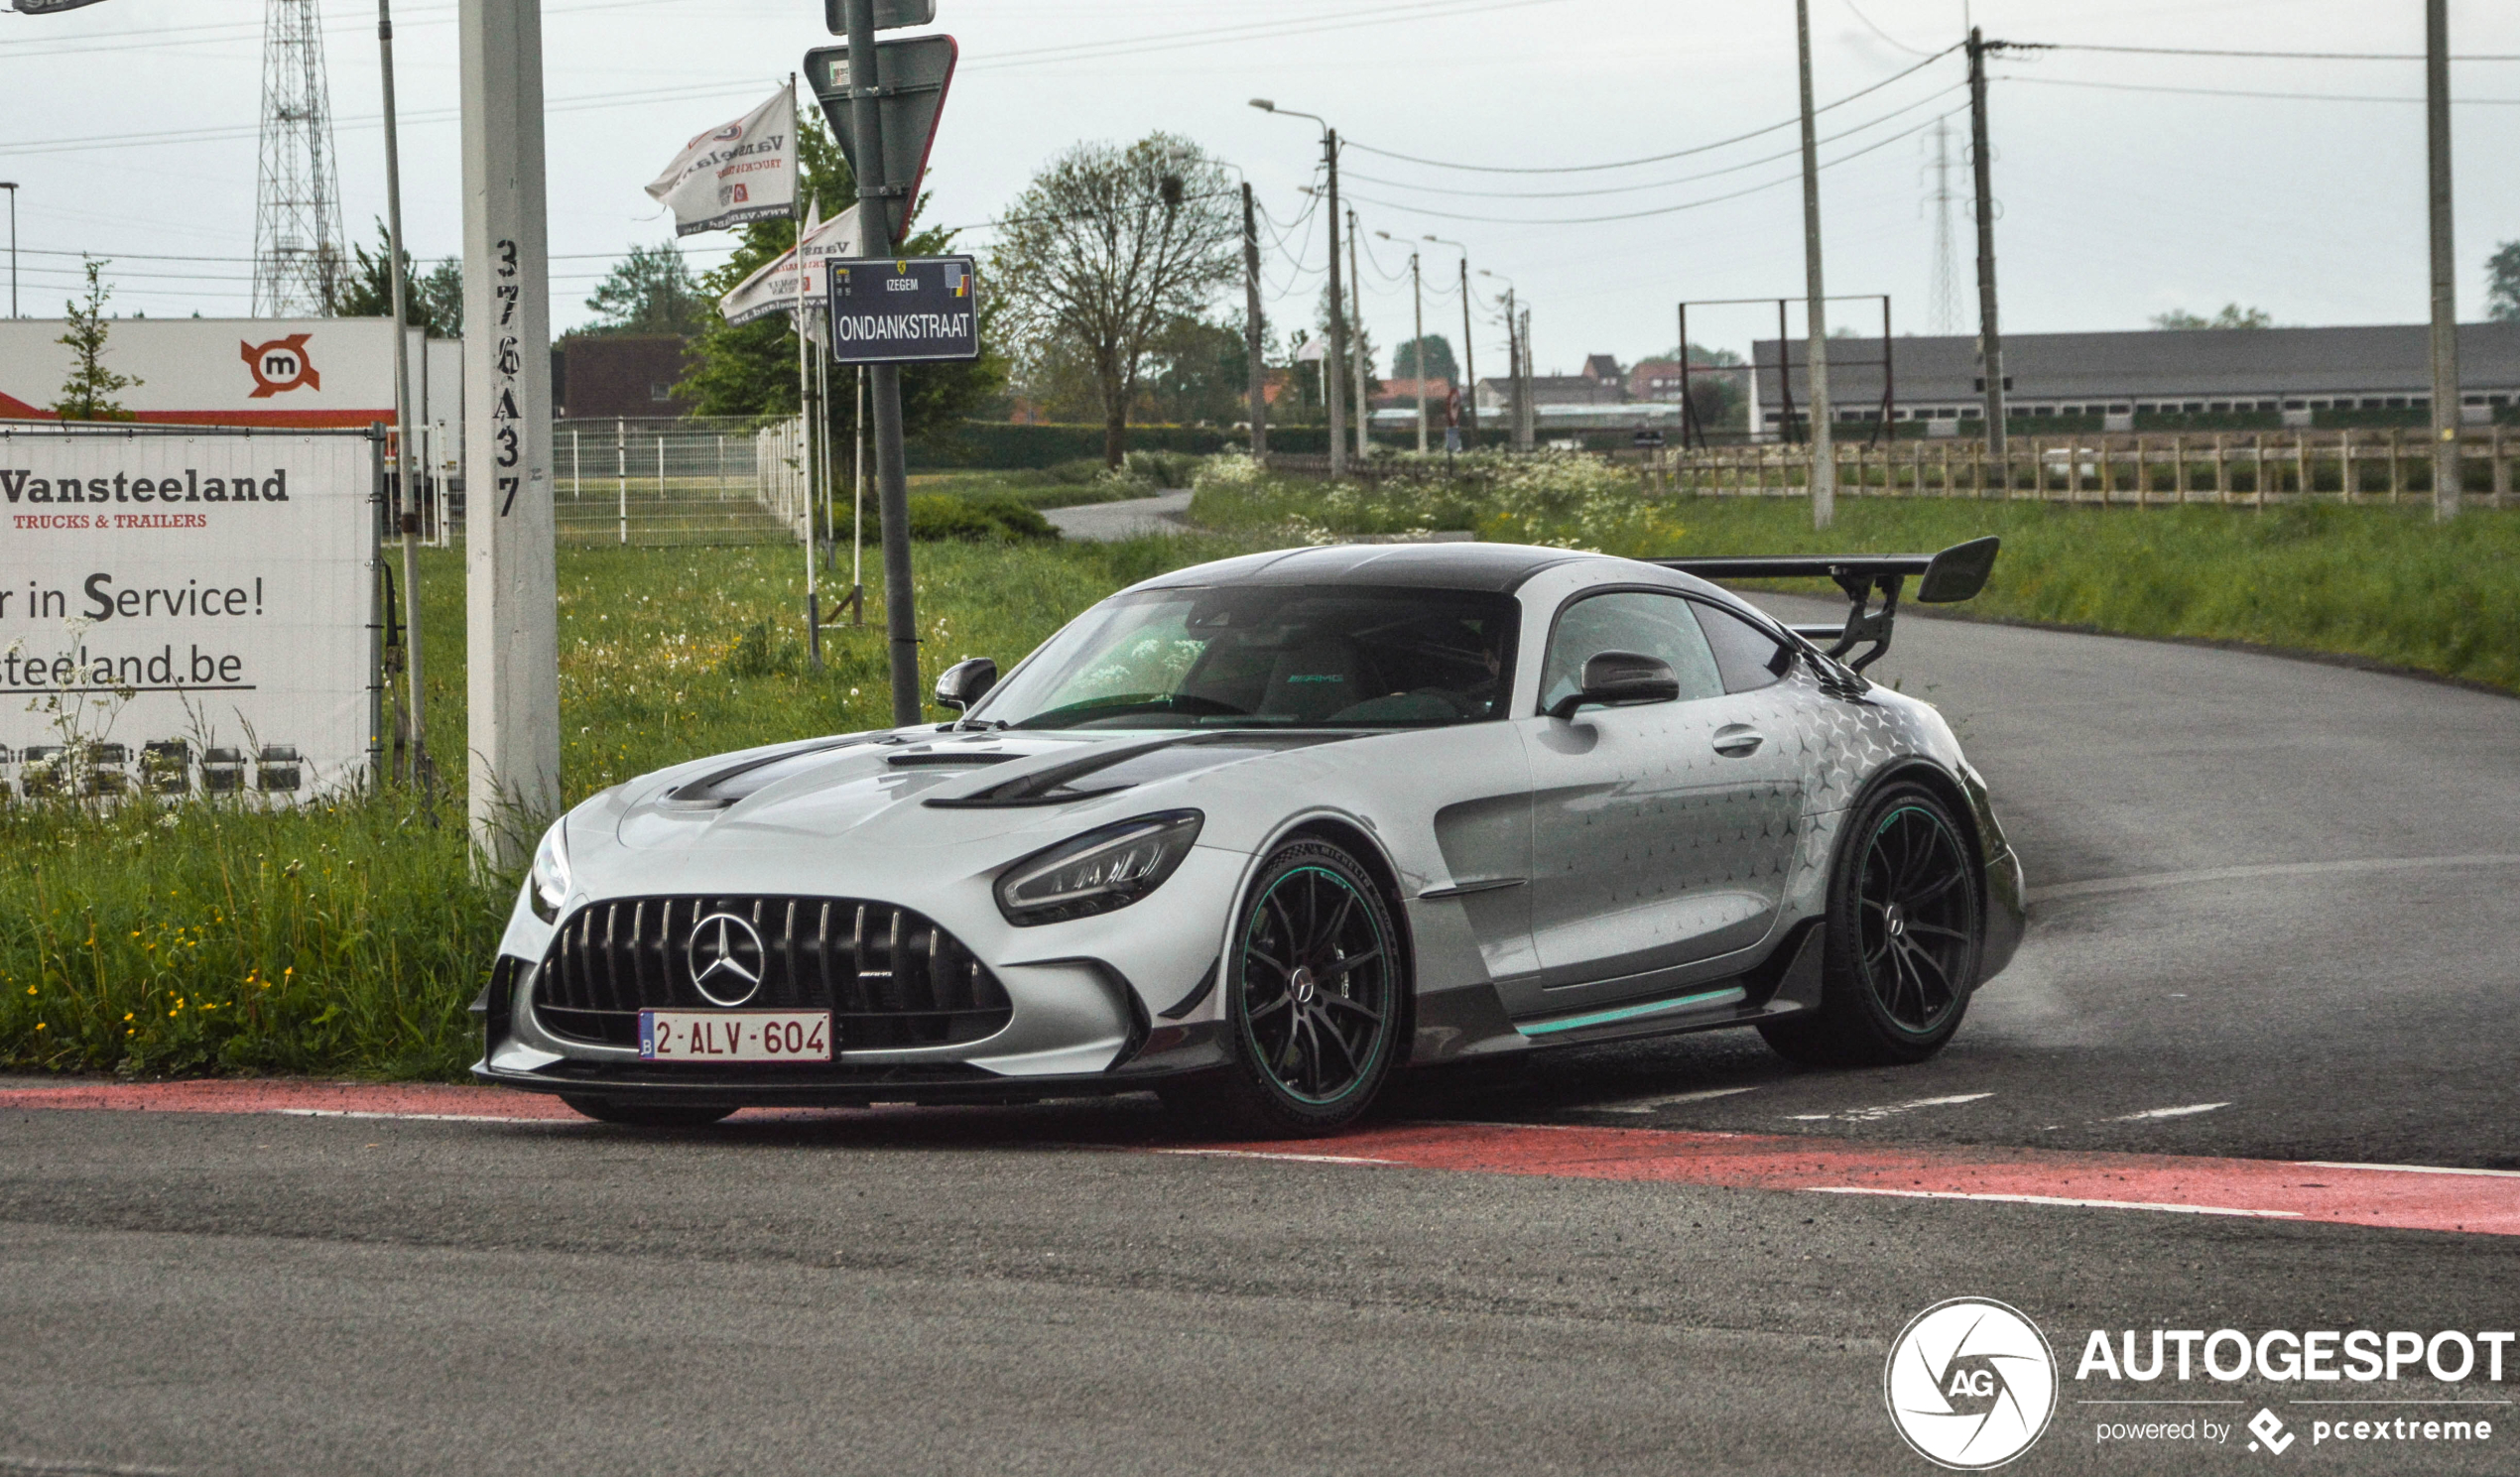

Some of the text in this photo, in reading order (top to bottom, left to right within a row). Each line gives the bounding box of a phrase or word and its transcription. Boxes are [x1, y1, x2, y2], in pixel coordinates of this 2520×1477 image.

[886, 279, 919, 292] IZEGEM
[839, 313, 969, 341] ONDANKSTRAAT
[266, 356, 296, 375] m
[0, 469, 289, 503] Vansteeland
[13, 514, 207, 529] TRUCKS & TRAILERS
[30, 580, 65, 618] in
[83, 572, 263, 622] Service!
[0, 644, 242, 686] teeland.be
[1322, 846, 1371, 888] MICHELIN
[643, 1040, 653, 1054] B
[657, 1021, 824, 1054] 2-ALV-604
